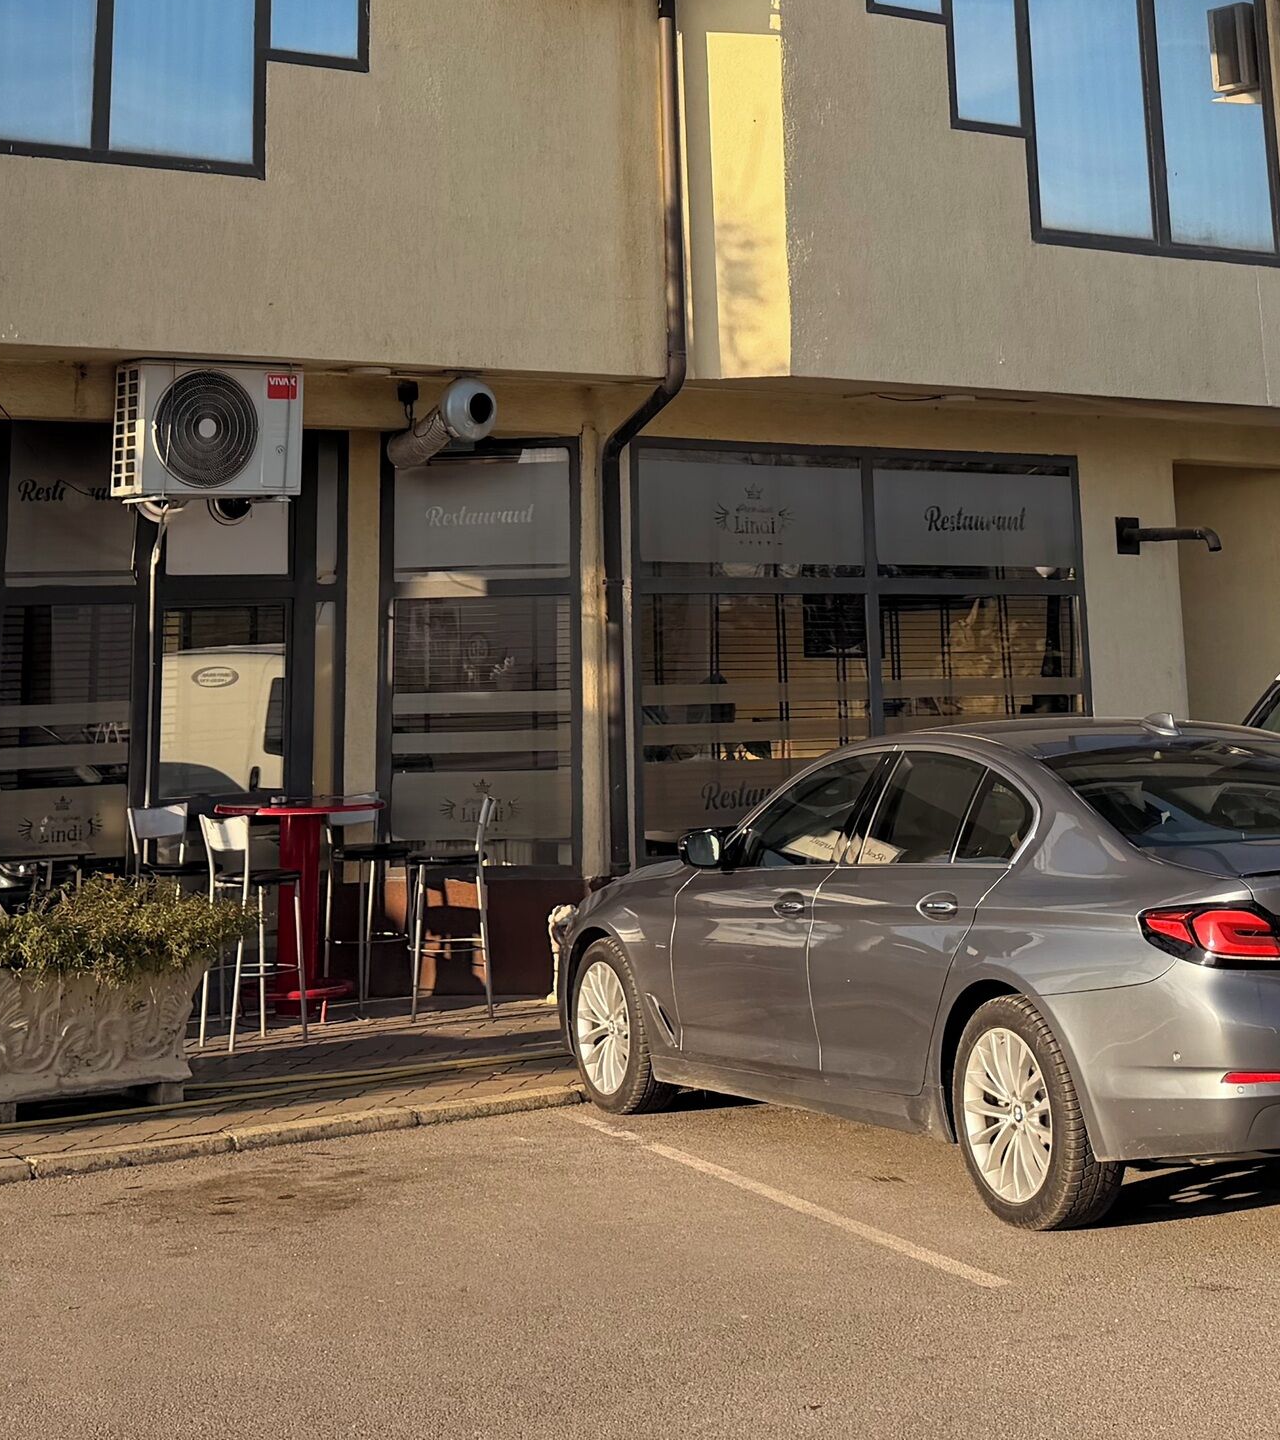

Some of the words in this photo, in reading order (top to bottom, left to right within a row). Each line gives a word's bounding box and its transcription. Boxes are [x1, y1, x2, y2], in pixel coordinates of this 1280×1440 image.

[269, 376, 296, 387] VIVAX
[425, 503, 535, 527] Restaurant
[924, 505, 1026, 532] Restaurant
